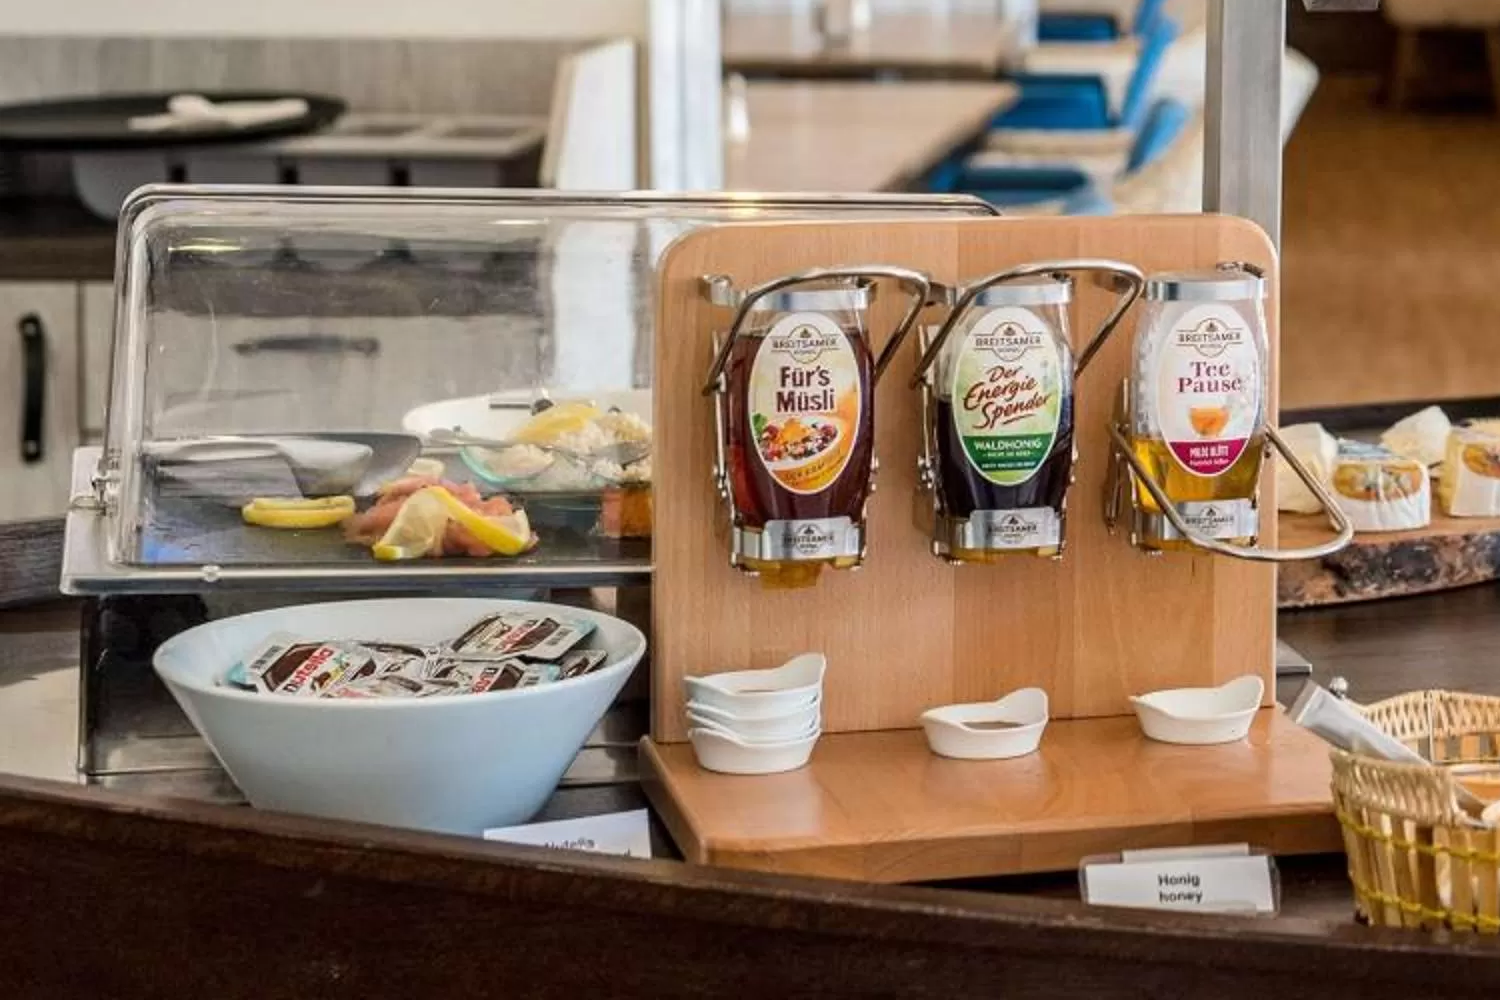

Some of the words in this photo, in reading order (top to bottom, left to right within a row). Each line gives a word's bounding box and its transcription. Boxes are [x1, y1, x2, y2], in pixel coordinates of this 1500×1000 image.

[975, 335, 1041, 347] BREITSAMER
[1178, 331, 1241, 343] BREITSAMER
[985, 365, 1024, 383] Der
[1190, 361, 1231, 377] Tee
[963, 375, 1038, 411] Energie
[1177, 377, 1242, 393] Pause
[776, 388, 835, 413] Müsli
[972, 392, 1052, 429] Spender
[974, 439, 1042, 452] WALDHONIG
[282, 647, 335, 693] nutella
[1158, 872, 1201, 887] Honig
[1159, 889, 1203, 904] honey
